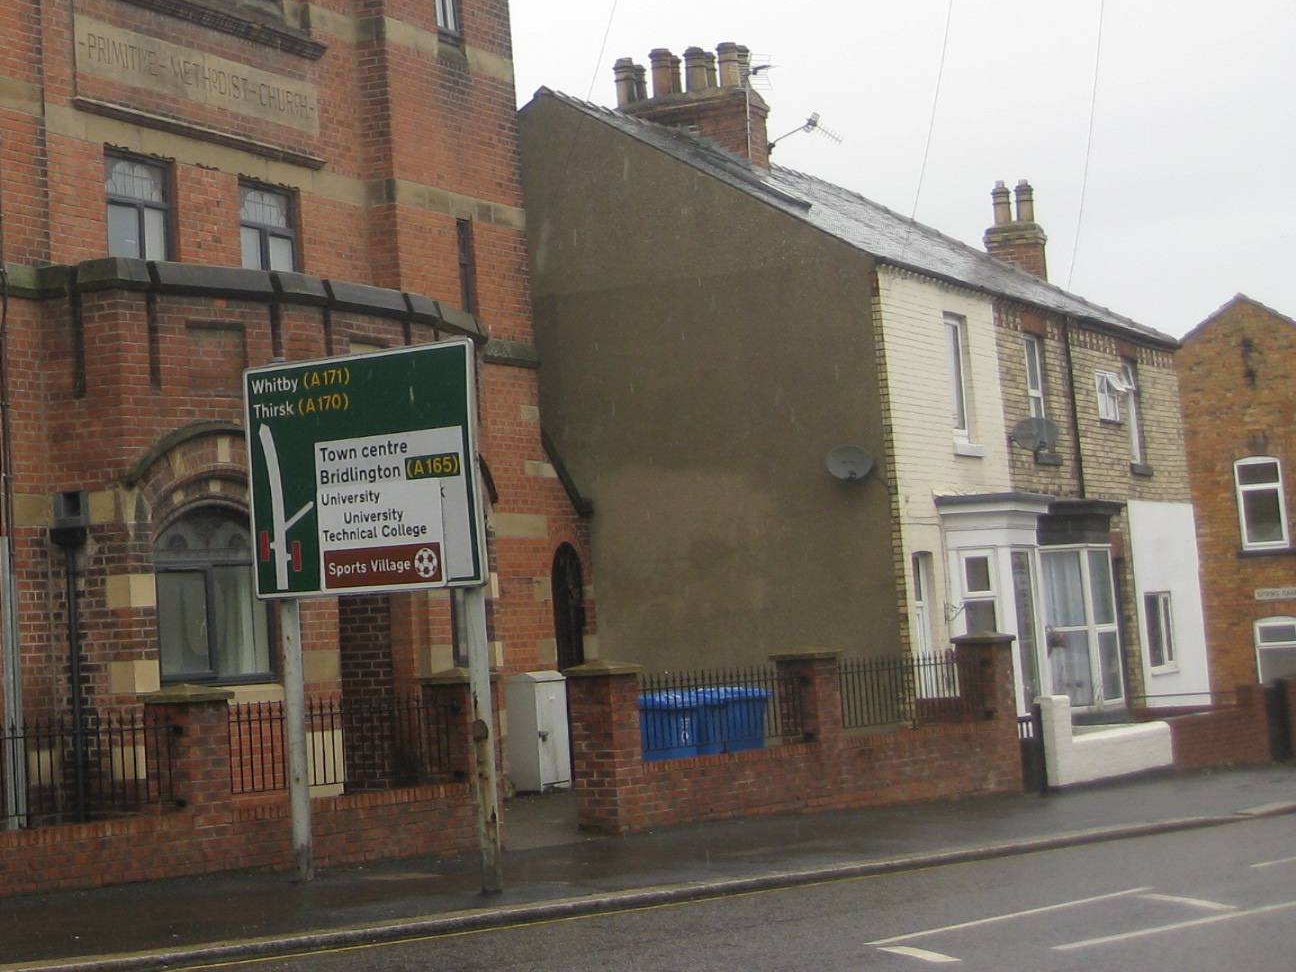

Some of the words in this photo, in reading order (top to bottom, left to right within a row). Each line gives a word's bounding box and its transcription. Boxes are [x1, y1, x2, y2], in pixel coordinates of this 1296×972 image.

[251, 376, 299, 395] Whitby
[253, 400, 295, 419] Thirsk
[319, 447, 358, 462] Town
[361, 440, 408, 458] centre
[320, 464, 401, 484] Bridlington
[321, 490, 381, 506] University
[344, 508, 404, 524] University
[323, 526, 378, 542] Technical
[381, 523, 427, 538] College
[328, 560, 367, 577] Sports
[370, 558, 412, 574] Village
